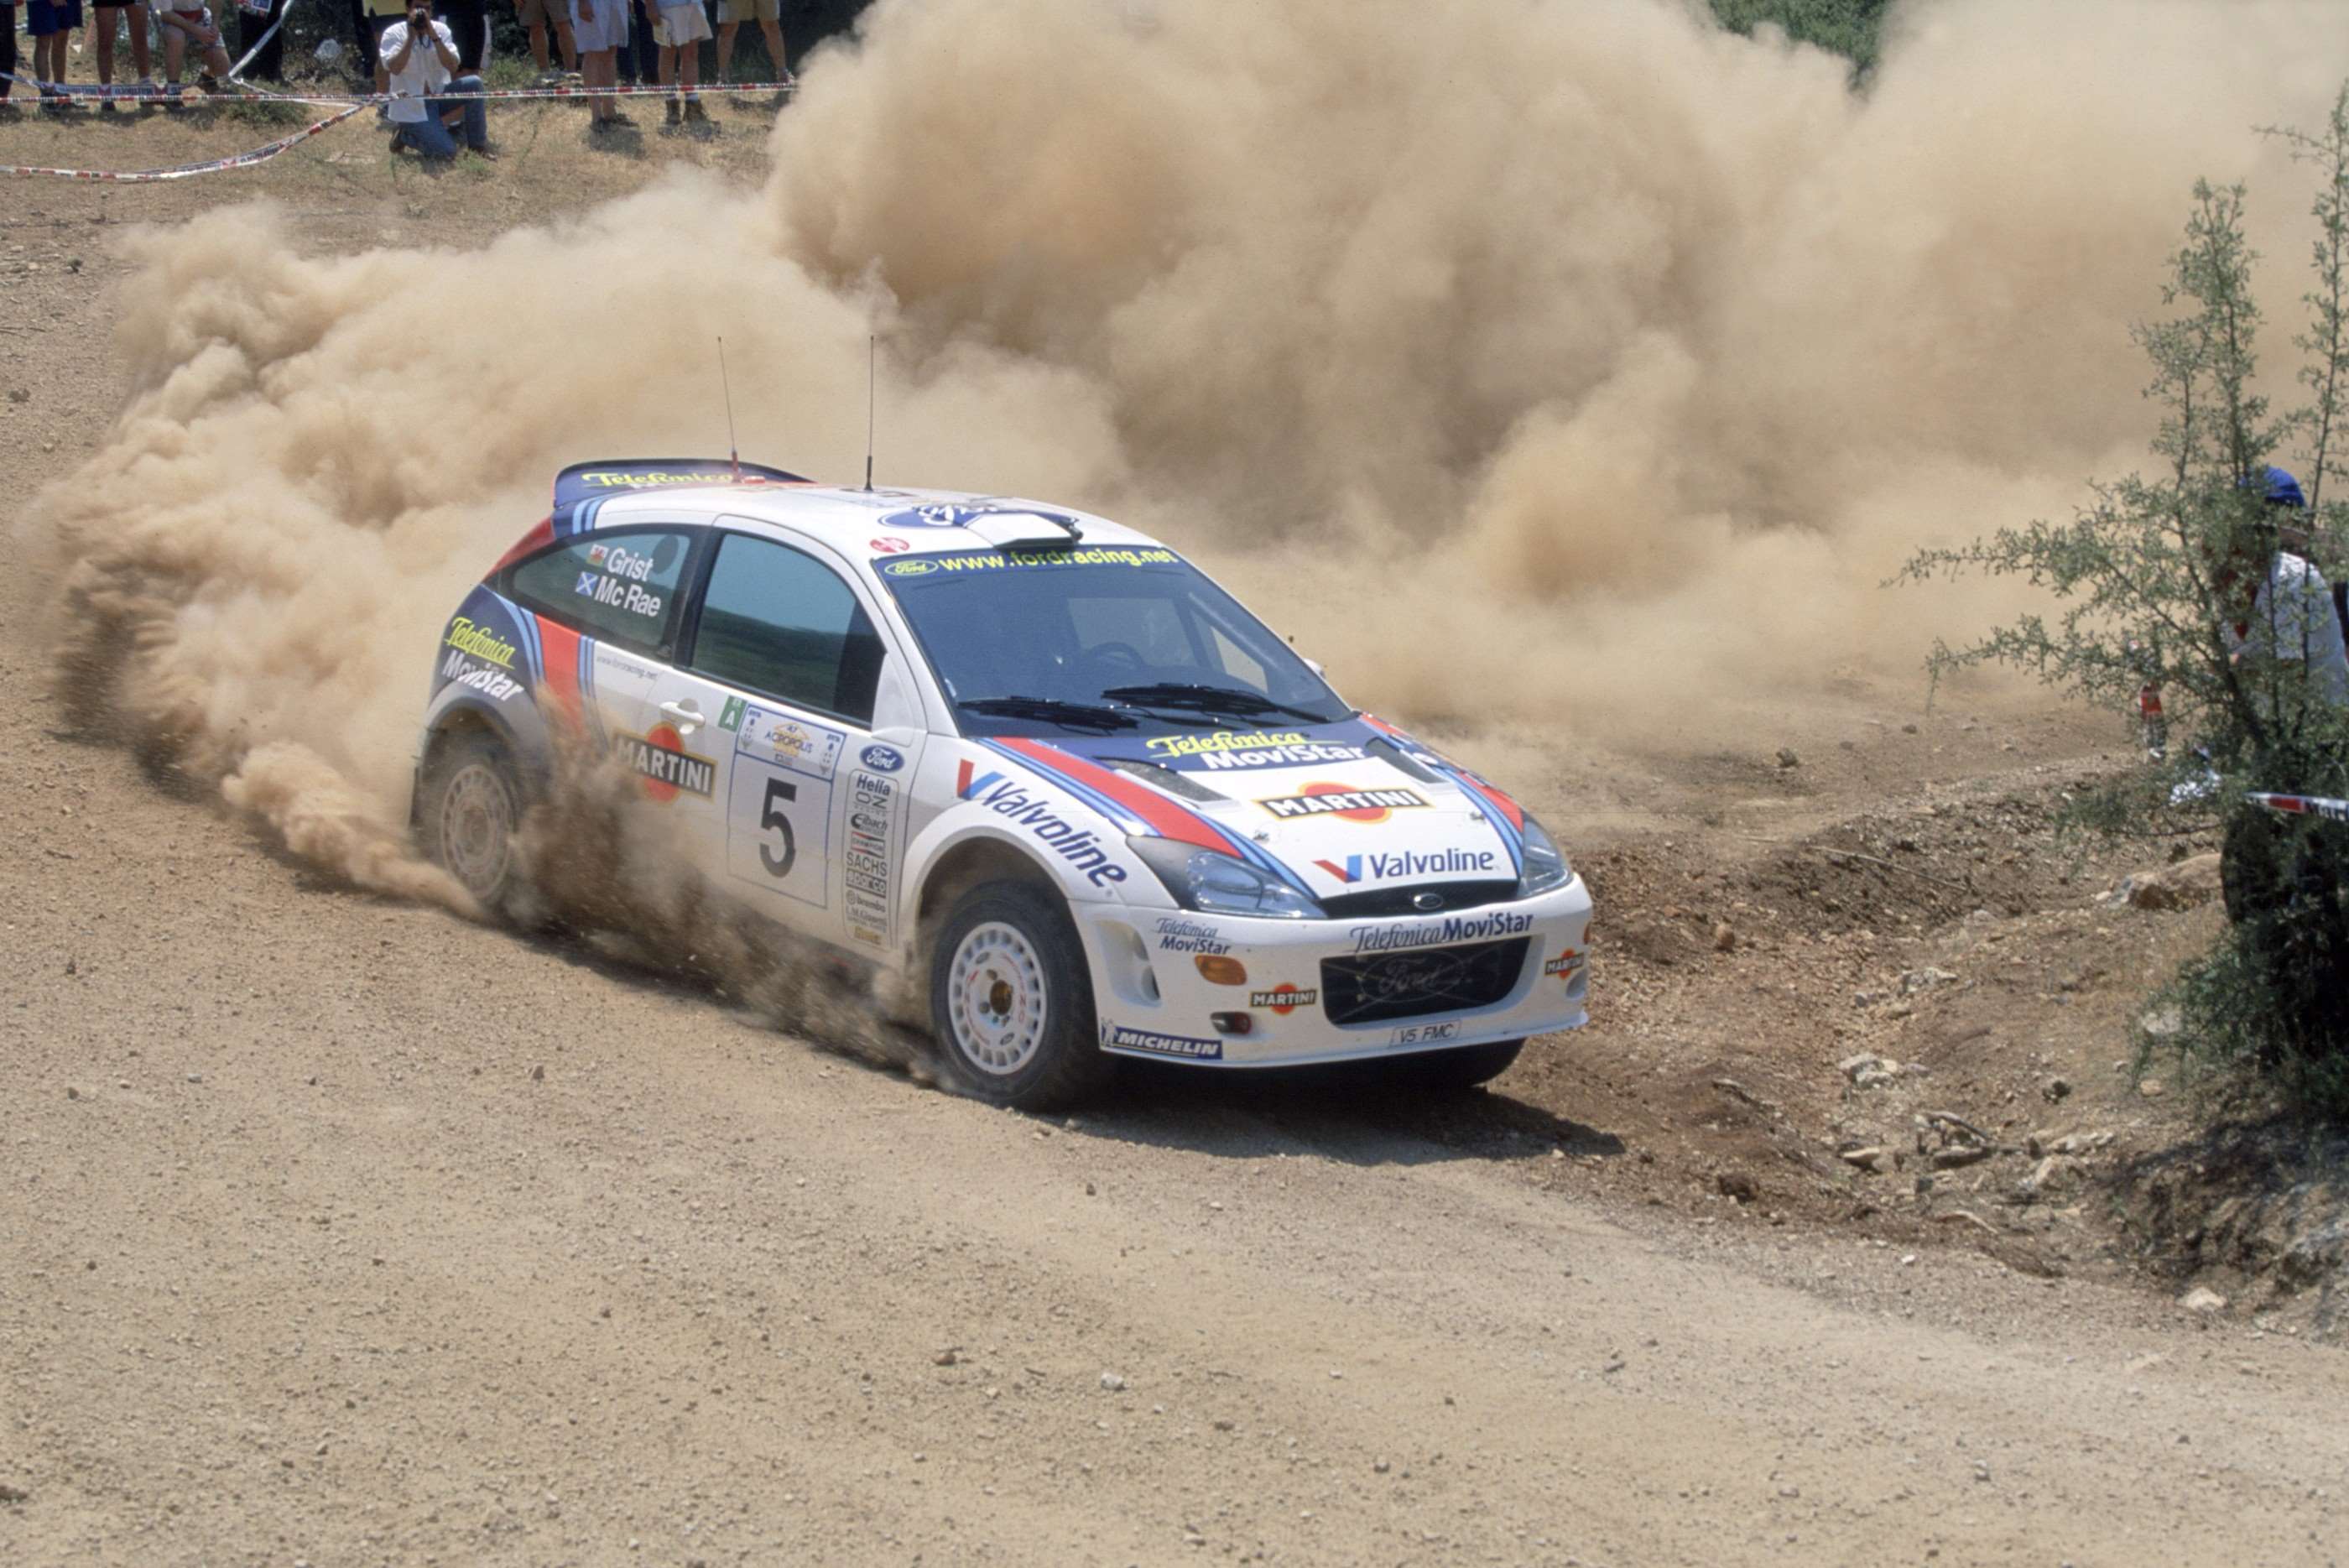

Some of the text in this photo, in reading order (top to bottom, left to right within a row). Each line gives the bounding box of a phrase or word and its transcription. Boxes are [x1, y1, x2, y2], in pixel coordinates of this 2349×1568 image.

[607, 547, 654, 582] Grist
[894, 561, 928, 575] Ford
[939, 549, 1178, 567] www.fordracing.net
[594, 576, 661, 617] Mc Rae
[725, 711, 735, 726] A
[617, 735, 711, 793] MARTINI
[867, 747, 897, 769] Ford
[857, 774, 891, 796] Hella
[1266, 789, 1423, 816] MARTINI
[759, 777, 797, 878] 5
[982, 782, 1128, 888] Valvoline
[846, 852, 888, 877] SACHS
[1369, 848, 1494, 879] Valvoline
[1253, 991, 1315, 1006] MARTINI
[1118, 1031, 1219, 1055] MICHELIN
[1399, 1024, 1455, 1044] V5 FMC
